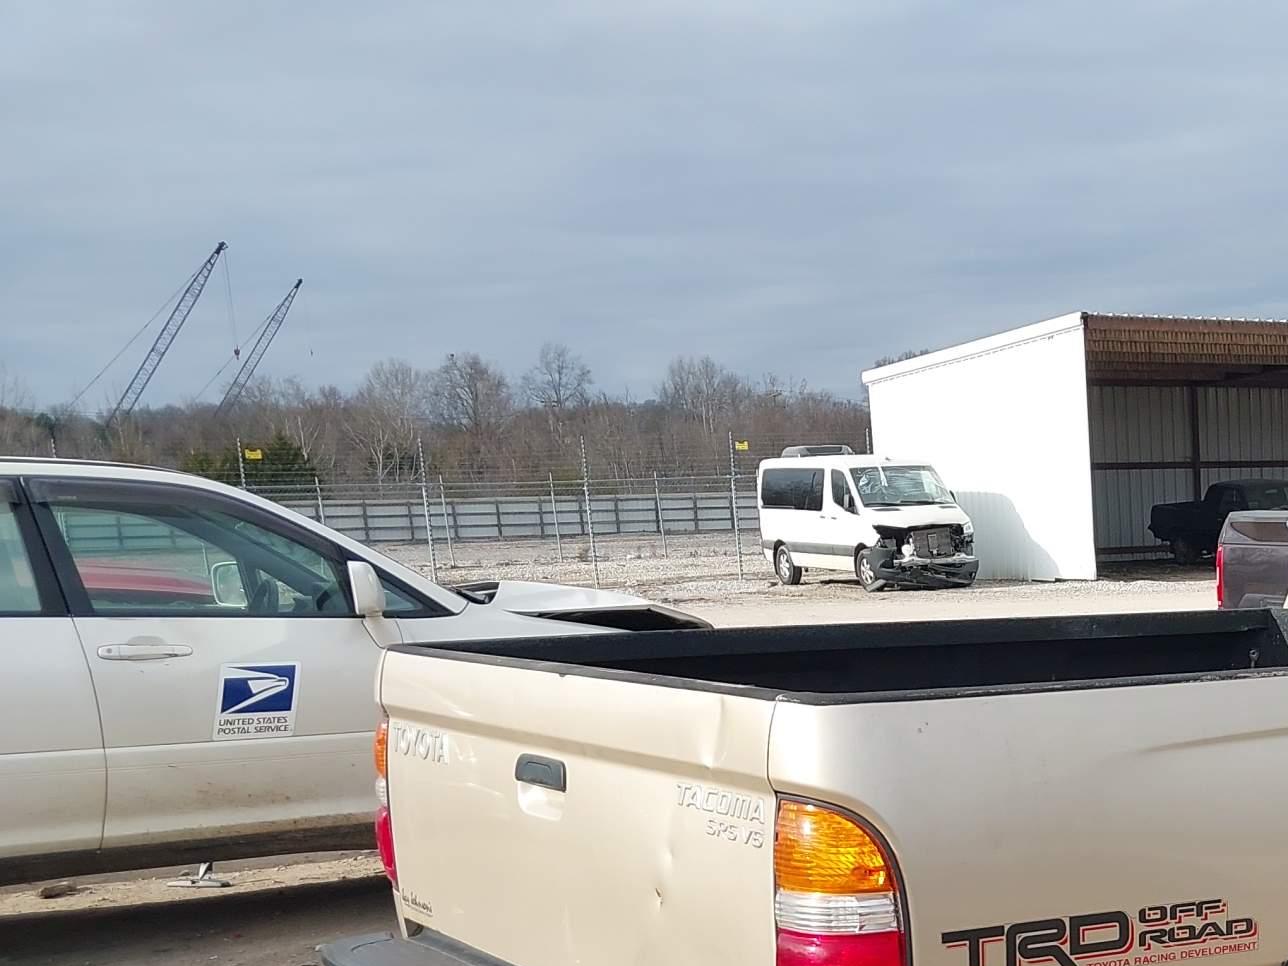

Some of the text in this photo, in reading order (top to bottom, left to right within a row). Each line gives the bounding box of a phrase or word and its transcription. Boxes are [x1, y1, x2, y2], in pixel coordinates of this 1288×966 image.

[217, 725, 289, 736] POSTAL SERVICE
[218, 716, 288, 727] UNITED STATES
[391, 723, 449, 764] TOYOTA
[677, 783, 765, 825] TACOMA
[1138, 899, 1227, 927] OFF
[1138, 918, 1258, 951] ROAD
[1134, 952, 1177, 965] RACING
[1180, 942, 1257, 959] DEVELOPMENT
